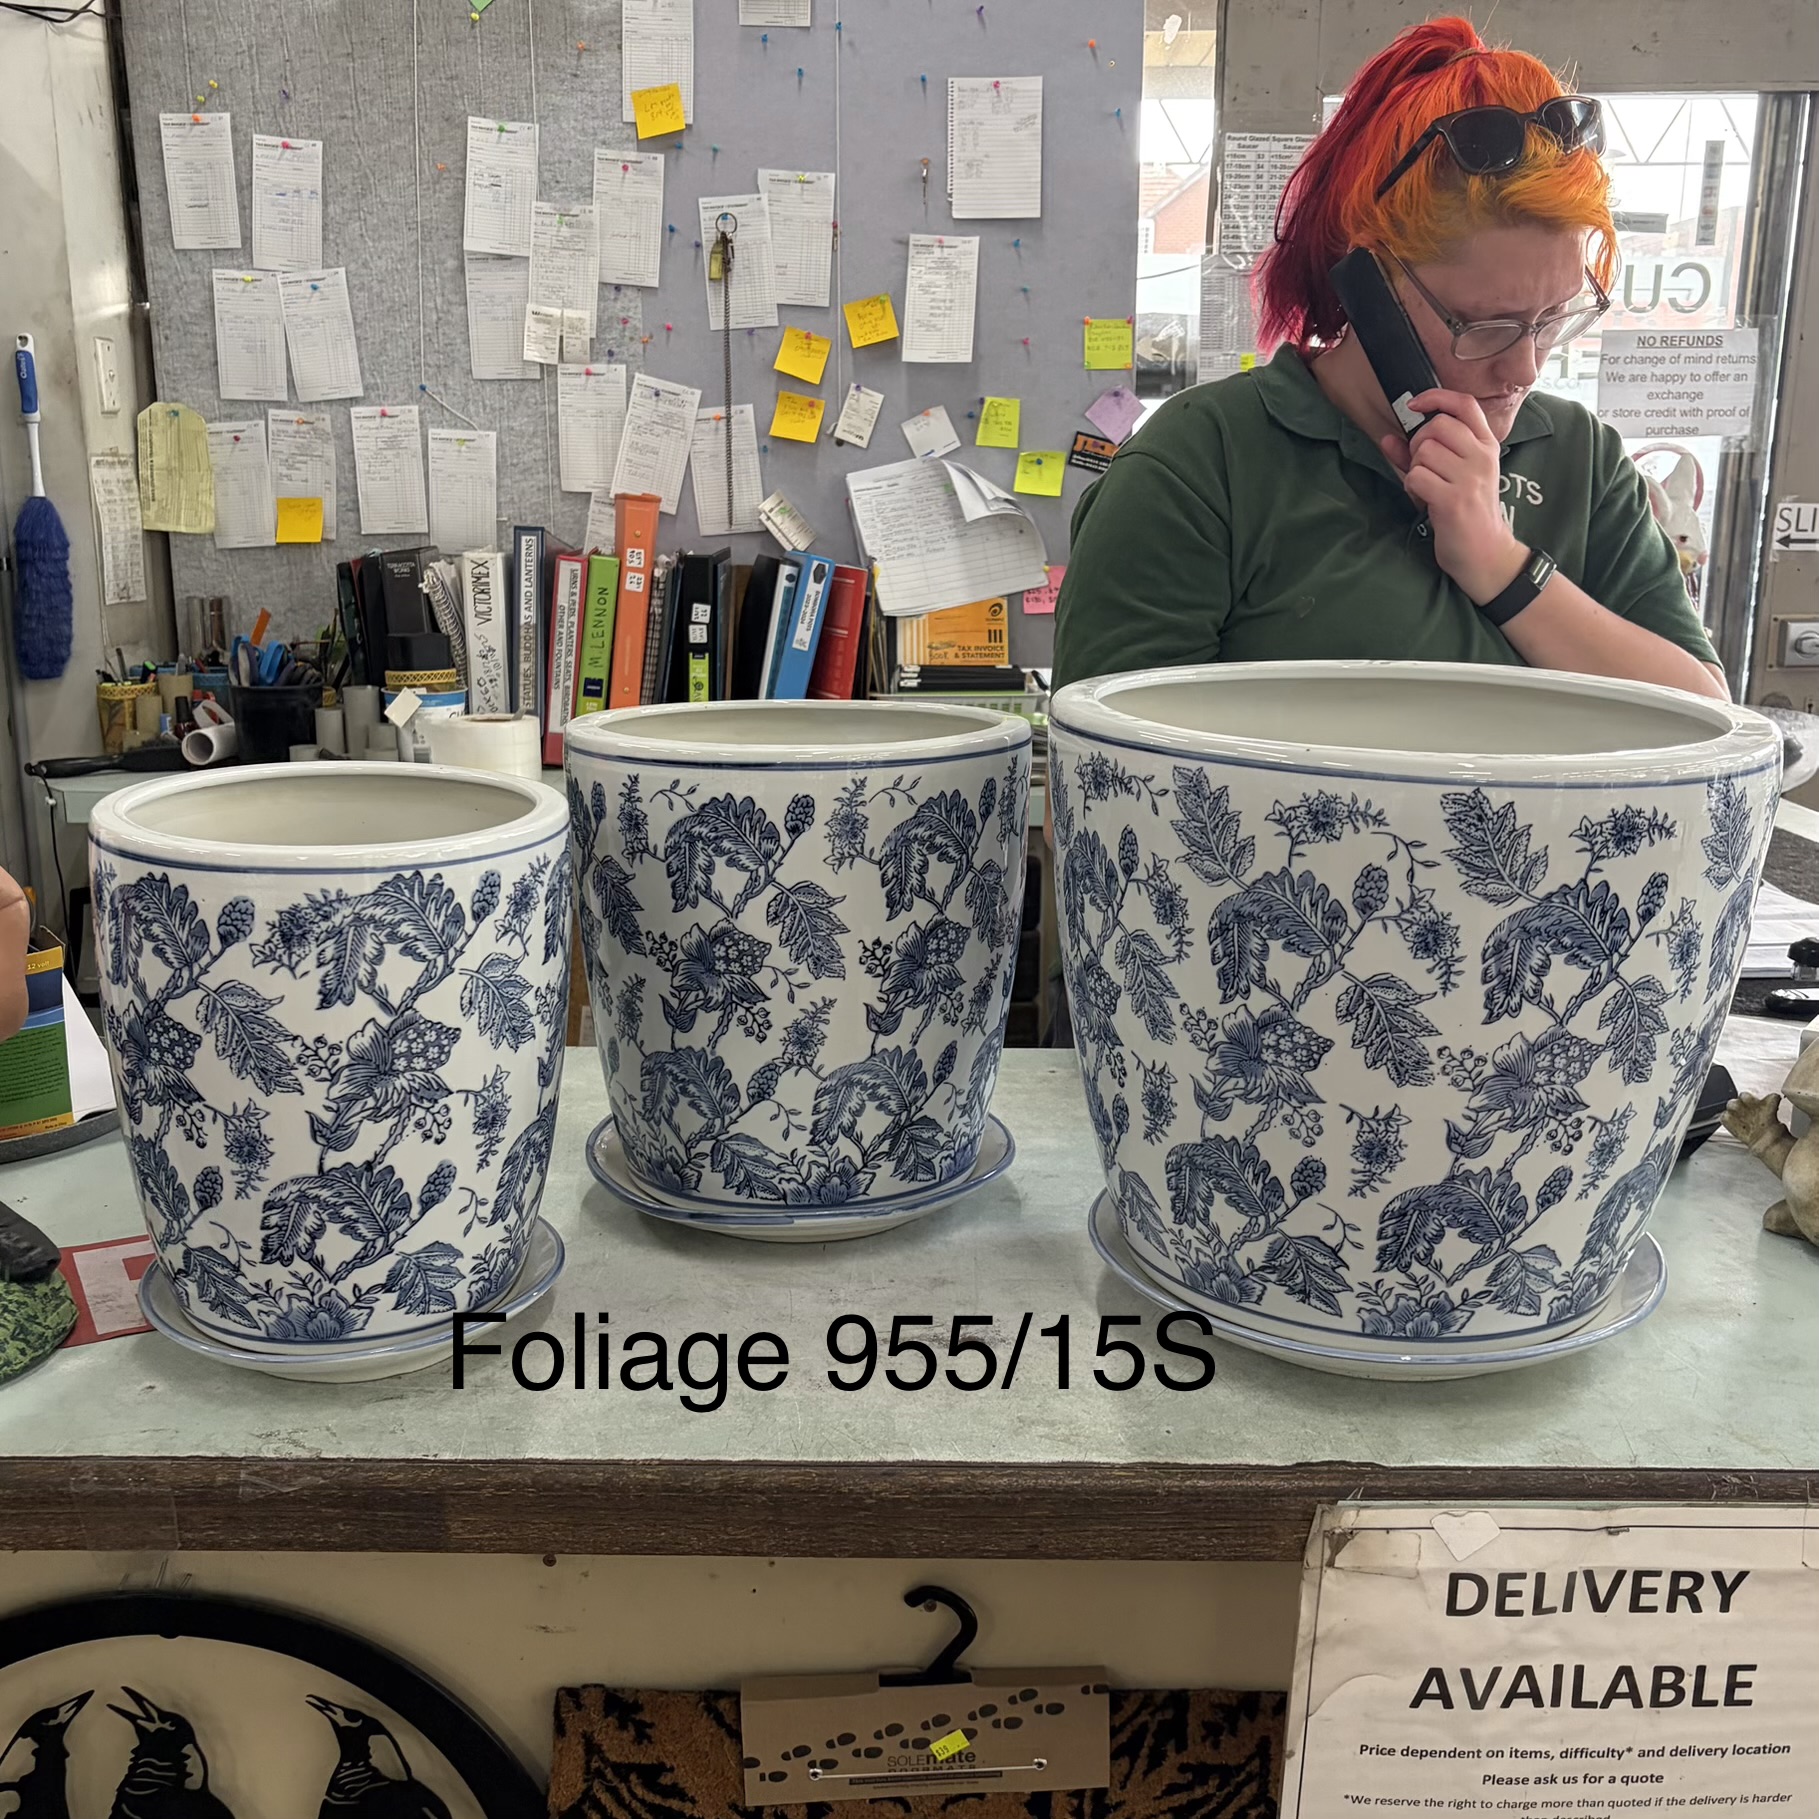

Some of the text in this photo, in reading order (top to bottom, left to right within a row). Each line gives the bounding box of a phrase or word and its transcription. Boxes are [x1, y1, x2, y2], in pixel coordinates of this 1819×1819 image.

[1636, 335, 1724, 346] NO REFUNDS
[1600, 353, 1757, 367] For change of mind returns
[1605, 371, 1748, 385] We are happy to offer an
[1647, 390, 1704, 402] exchange
[1598, 406, 1751, 420] or store credit with proof of
[1645, 425, 1700, 437] purchase
[1776, 507, 1817, 533] SLI
[570, 568, 580, 590] URNS
[470, 560, 492, 626] VICTORIMEX
[523, 538, 534, 708] STATUES, BUDDHAS AND LANTERNS
[554, 604, 566, 690] OTHER AND FOUNTAINS
[1446, 1570, 1751, 1617] DELIVERY
[1409, 1664, 1758, 1710] AVAILABLE
[1359, 1744, 1396, 1756] Price
[1400, 1746, 1482, 1760] dependent
[1486, 1750, 1504, 1759] on
[1509, 1747, 1555, 1761] items,
[1637, 1746, 1665, 1758] and
[1669, 1745, 1728, 1759] delivery
[1732, 1743, 1791, 1756] location
[1482, 1773, 1664, 1786] Please ask us for a quote
[1374, 1798, 1421, 1807] reserve
[1424, 1798, 1444, 1808] the
[1448, 1798, 1476, 1810] right
[1480, 1800, 1493, 1809] to
[1496, 1799, 1538, 1811] charge
[1541, 1800, 1573, 1809] more
[1577, 1798, 1605, 1808] than
[1608, 1798, 1652, 1810] quoted
[1654, 1796, 1663, 1807] if
[1666, 1796, 1686, 1806] the
[1689, 1794, 1737, 1808] delivery
[1740, 1794, 1750, 1804] is
[1752, 1793, 1792, 1804] harder
